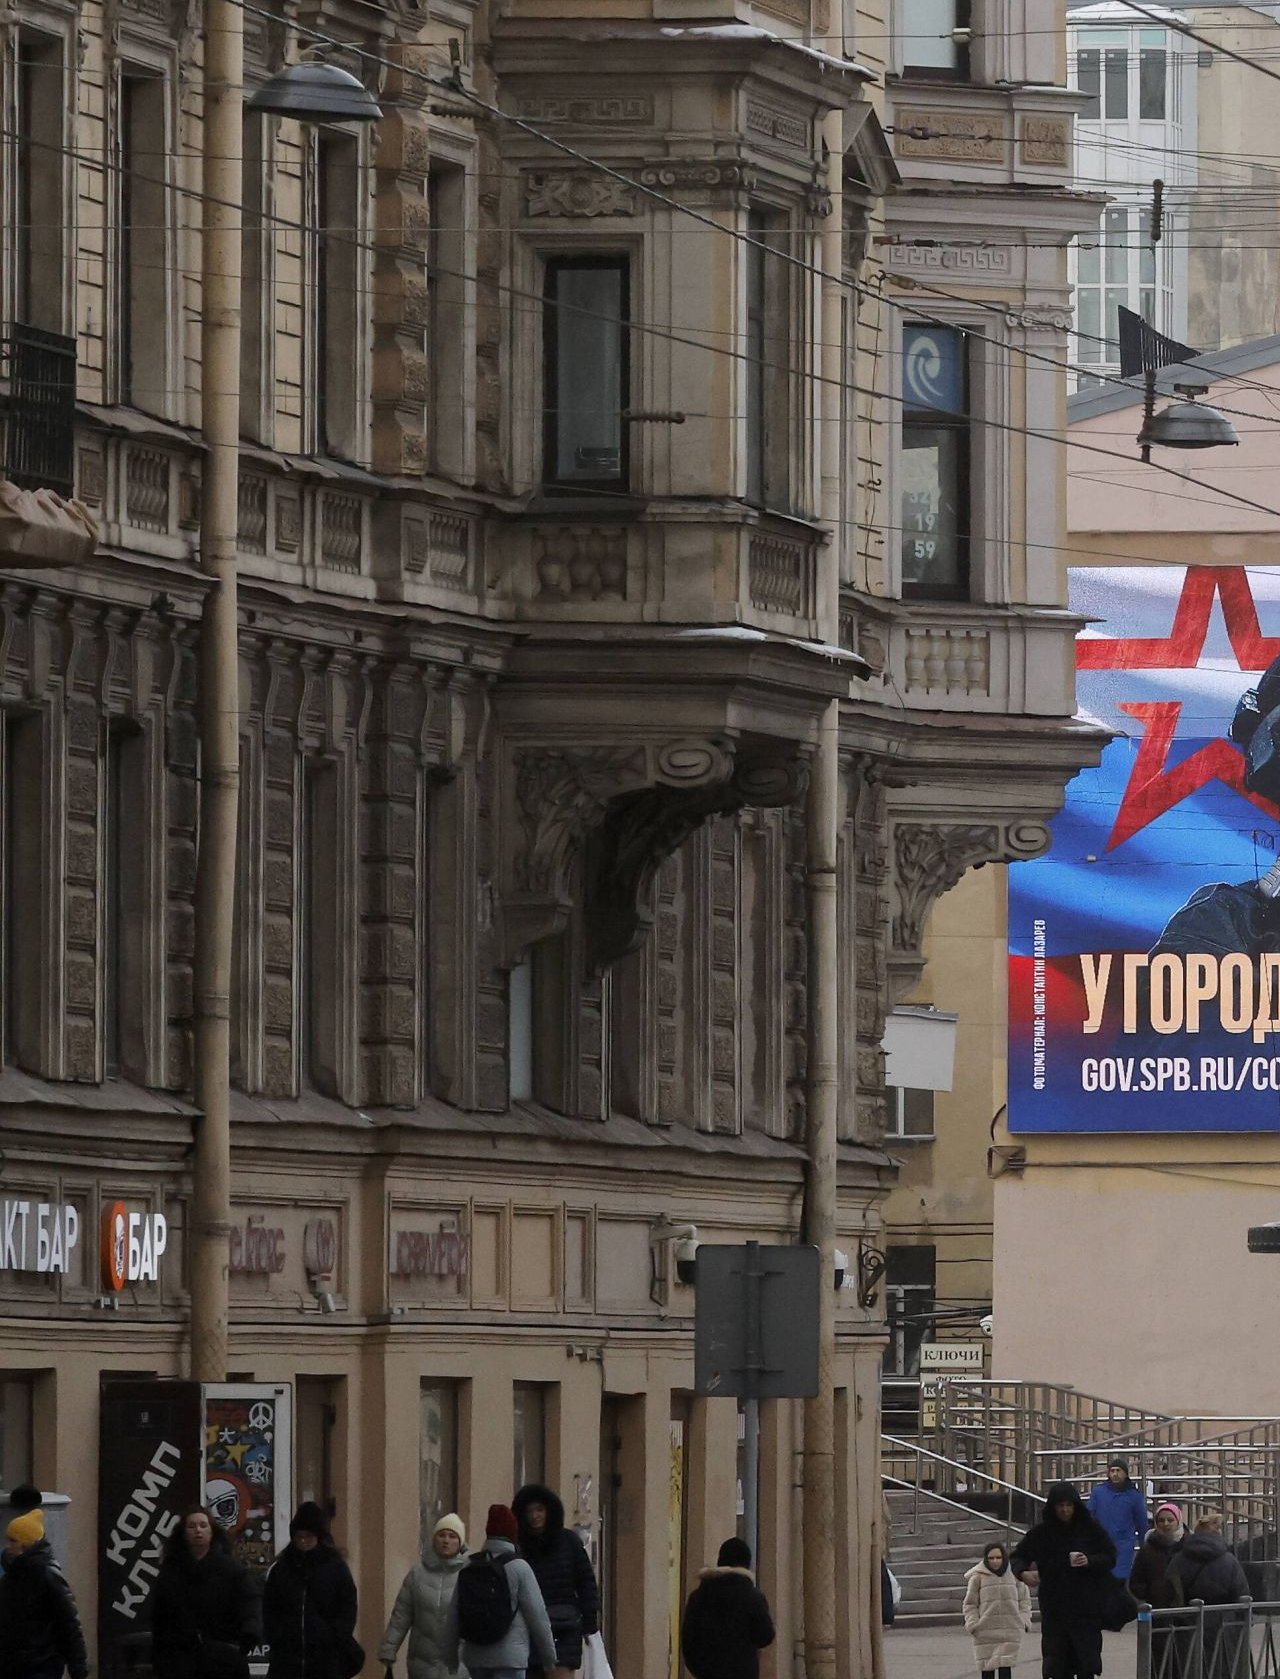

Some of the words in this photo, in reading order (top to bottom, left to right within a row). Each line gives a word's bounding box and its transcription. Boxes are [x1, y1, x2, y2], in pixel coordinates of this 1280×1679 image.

[914, 541, 936, 559] 59
[1033, 919, 1046, 958] ЛАЗАРЕВ
[1033, 958, 1046, 1014] КОНСТАНТИН
[1080, 953, 1113, 1034] У
[1033, 1013, 1046, 1090] ФОТОМАТЕРИАЛ:
[37, 1203, 78, 1273] БАР
[128, 1212, 167, 1281] БАР
[923, 1350, 980, 1362] КЛЮЧИ
[106, 1440, 181, 1567] КОМП
[247, 1645, 271, 1657] АР
